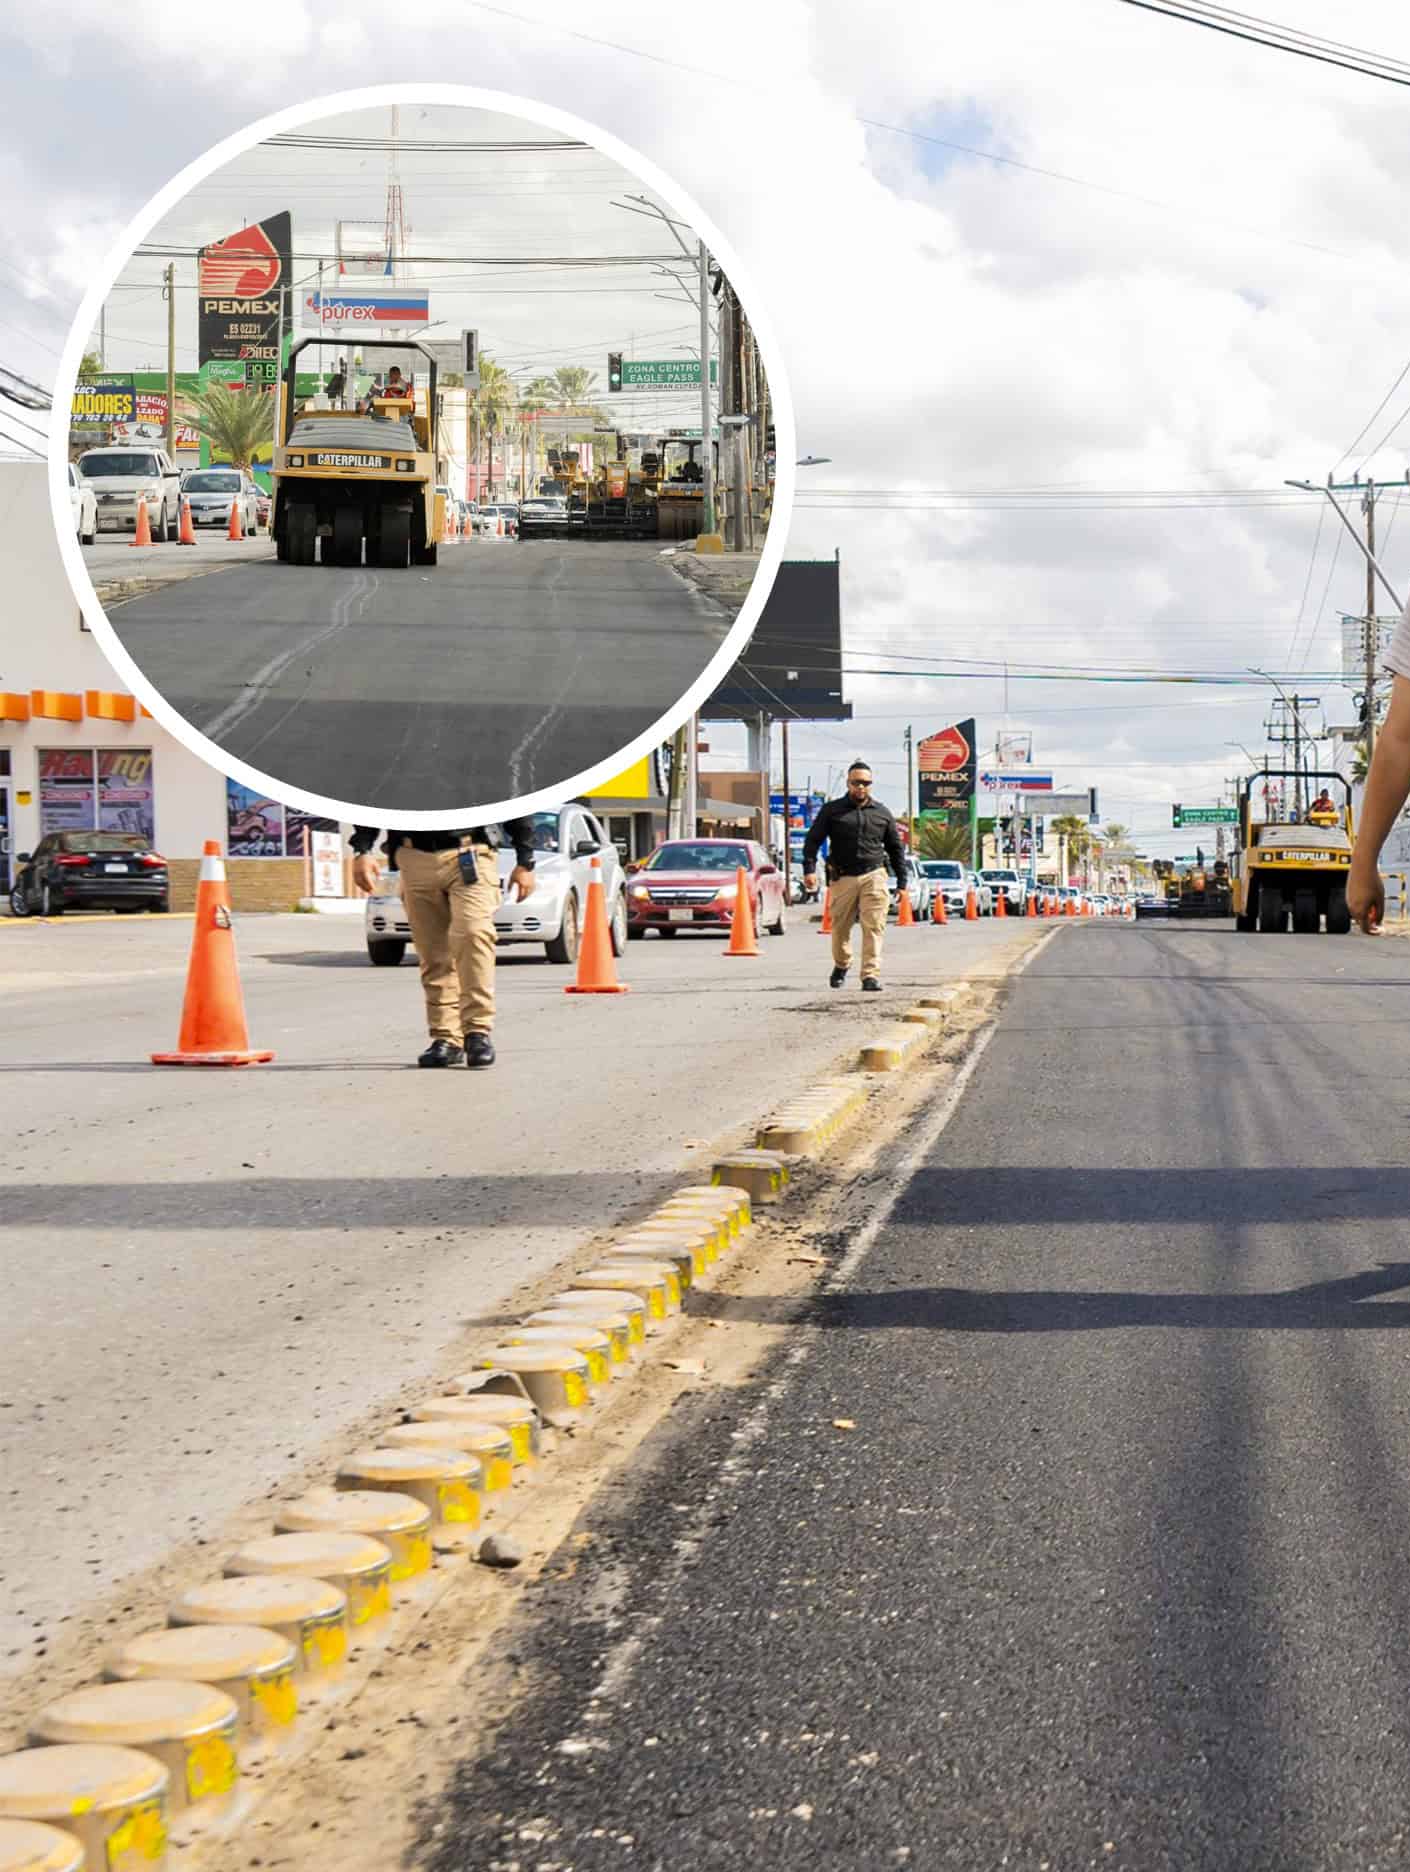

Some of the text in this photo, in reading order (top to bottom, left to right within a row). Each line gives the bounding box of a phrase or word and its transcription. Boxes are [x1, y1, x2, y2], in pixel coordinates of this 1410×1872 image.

[205, 301, 280, 314] PEMEX
[628, 363, 700, 373] ZONA CENTRO
[630, 373, 694, 382] EAGLE PASS
[318, 453, 383, 467] CATERPILLAR
[921, 773, 969, 782] PEMEX
